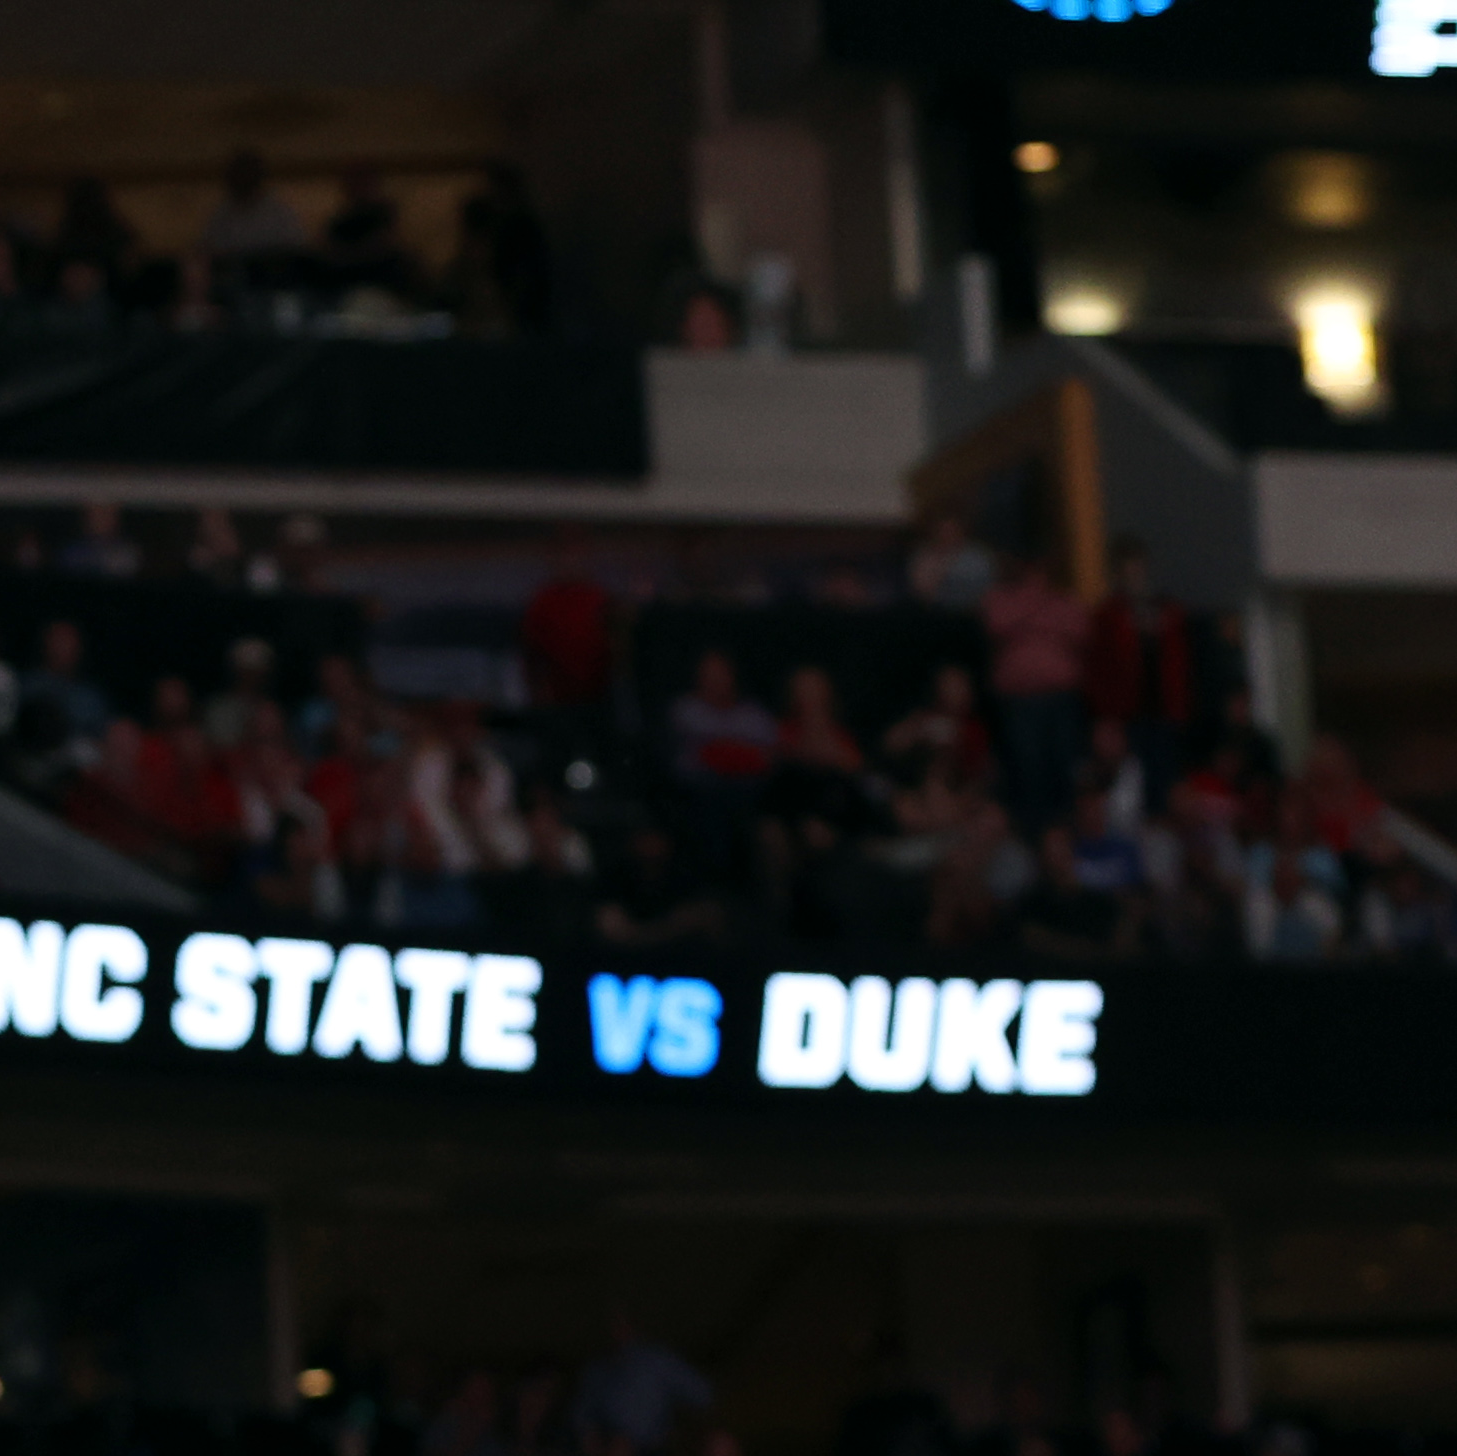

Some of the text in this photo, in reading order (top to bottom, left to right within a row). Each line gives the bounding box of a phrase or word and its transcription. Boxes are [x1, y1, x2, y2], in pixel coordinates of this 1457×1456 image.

[171, 931, 542, 1072] STATE
[588, 972, 724, 1077] VS
[756, 971, 1103, 1097] DUKE
